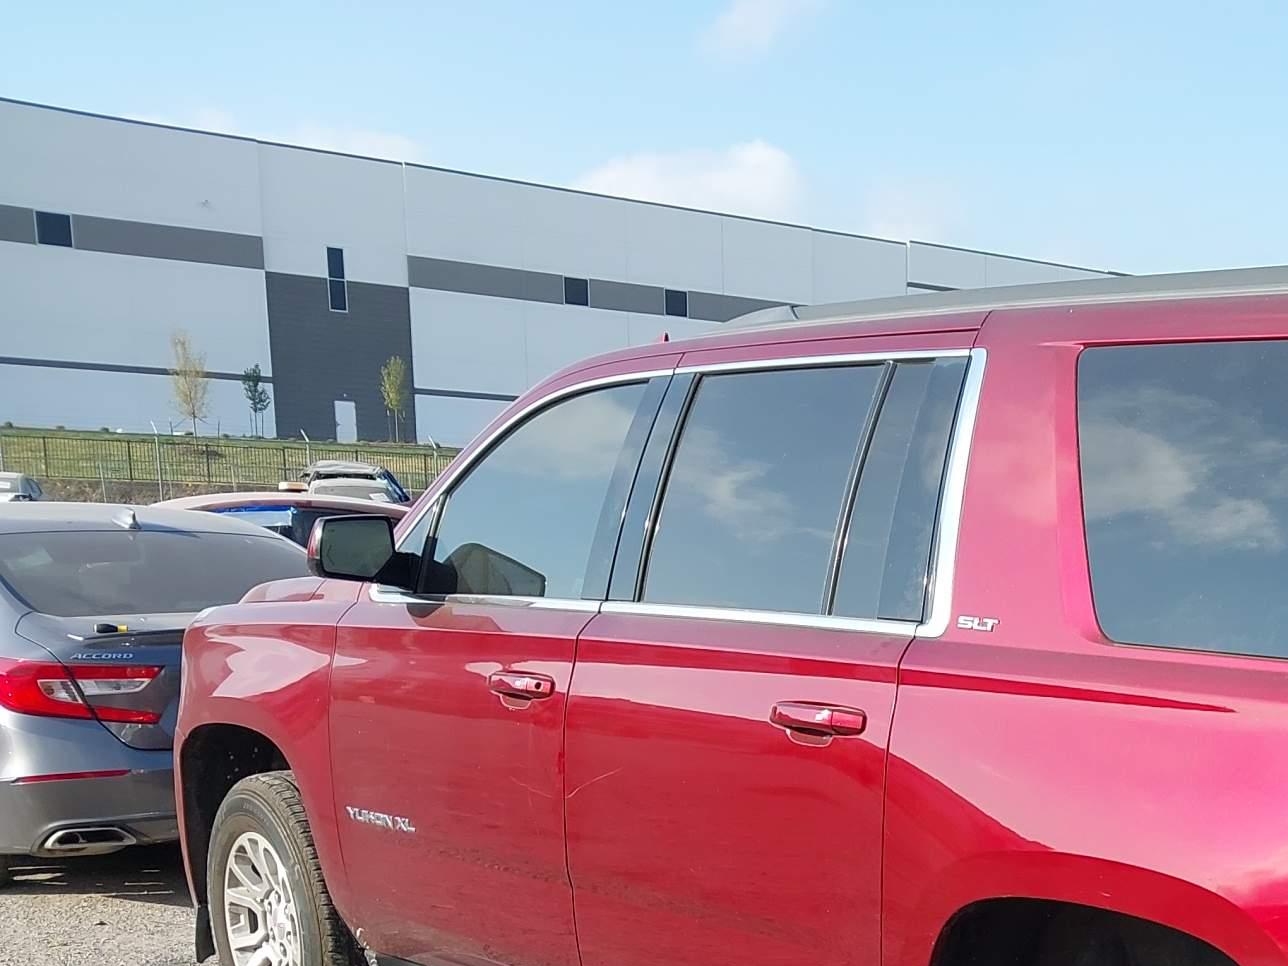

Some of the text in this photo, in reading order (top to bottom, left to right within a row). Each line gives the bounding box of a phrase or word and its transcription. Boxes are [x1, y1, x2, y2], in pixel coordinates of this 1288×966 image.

[957, 615, 1000, 632] SLT
[345, 806, 416, 832] YUKON XL
